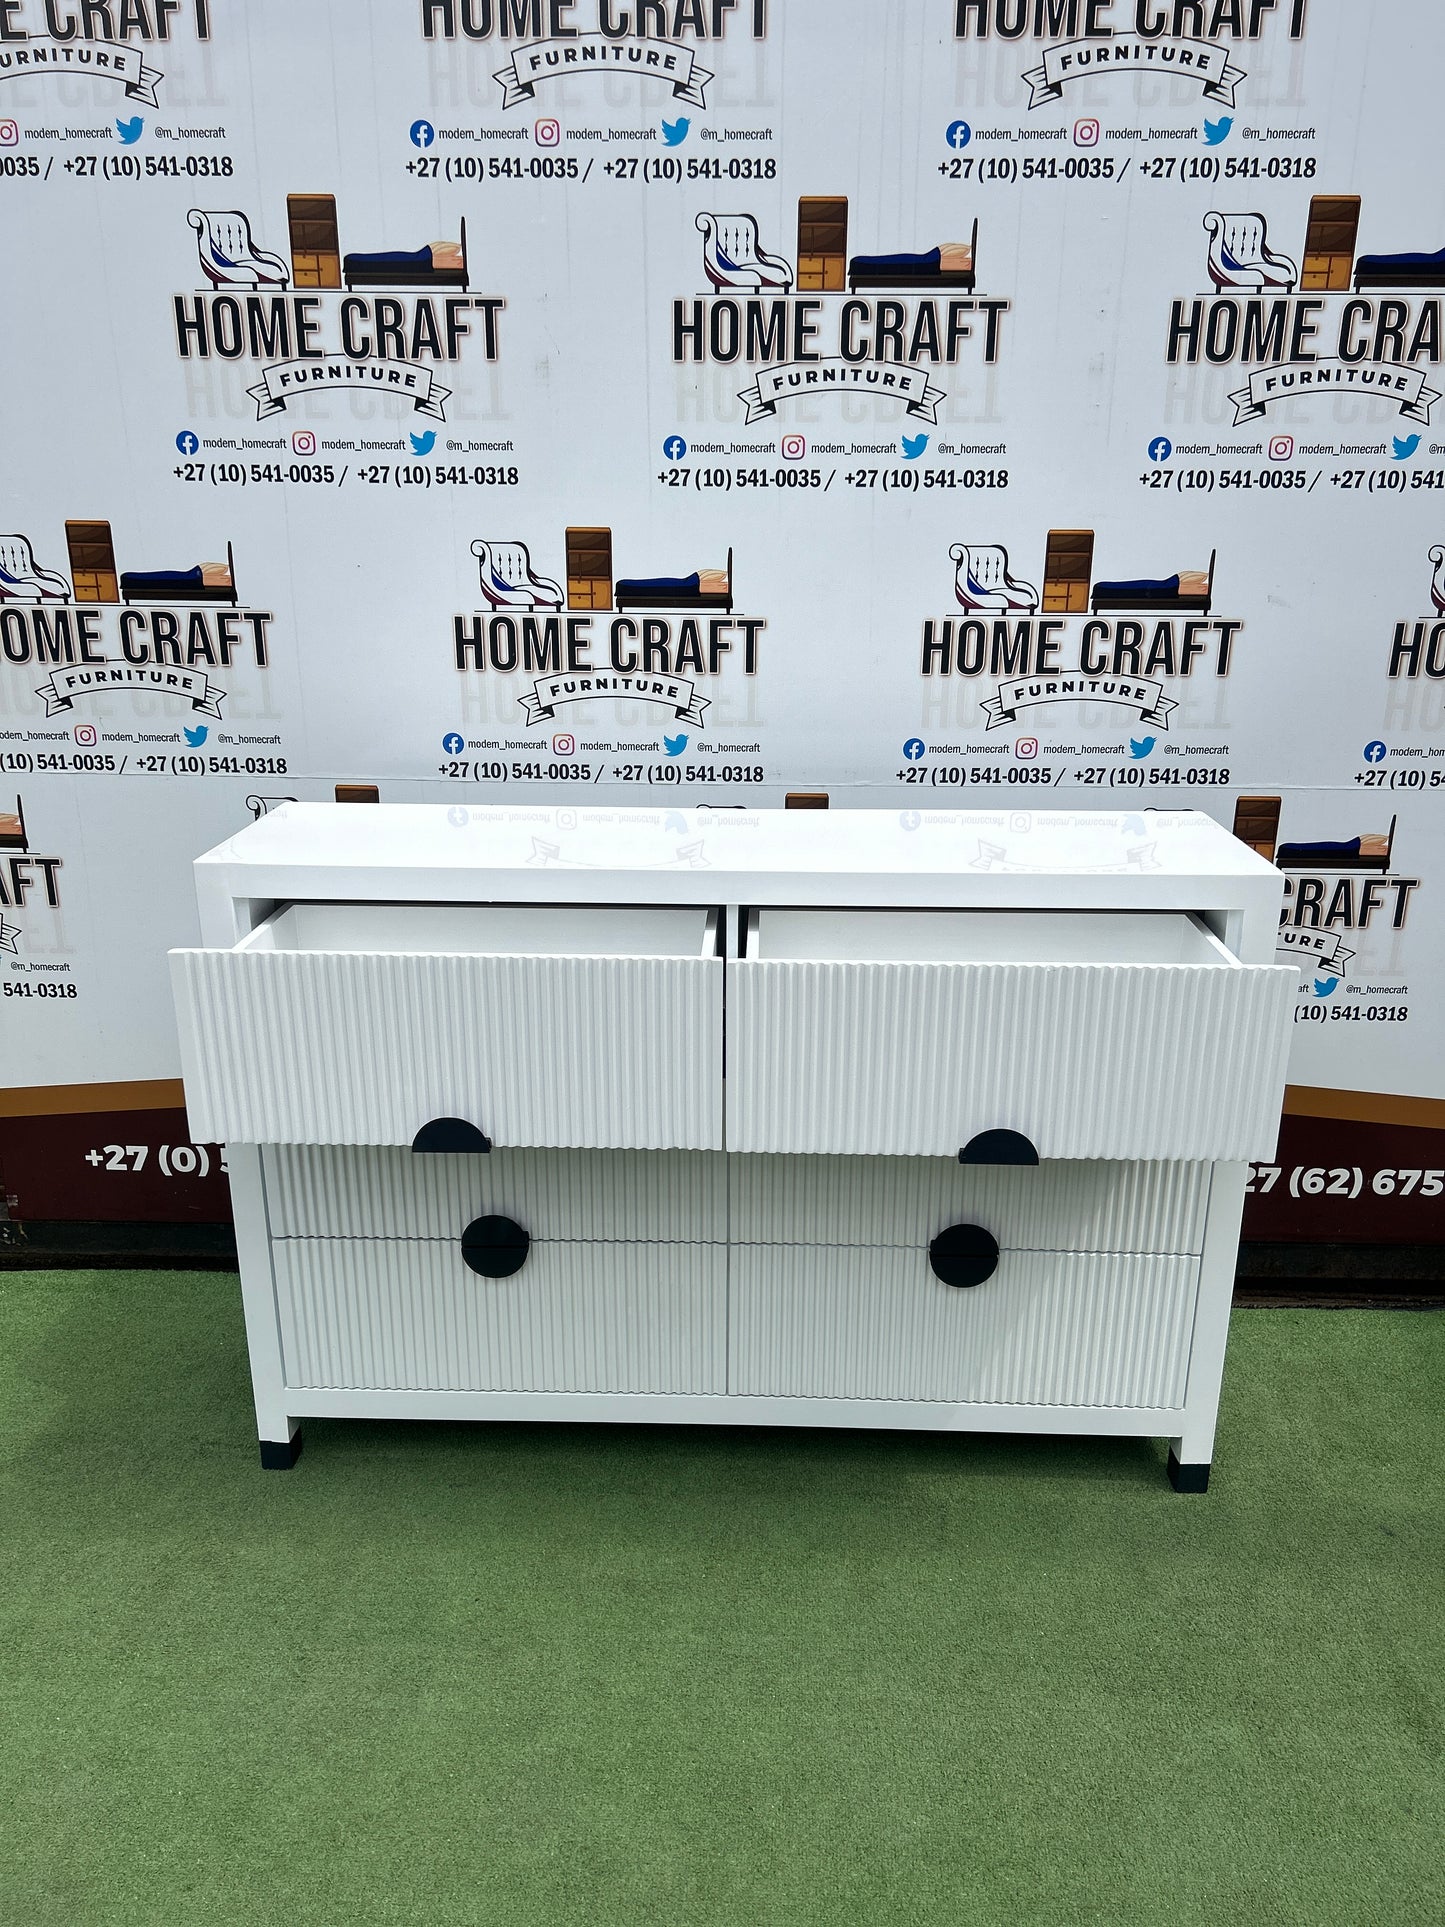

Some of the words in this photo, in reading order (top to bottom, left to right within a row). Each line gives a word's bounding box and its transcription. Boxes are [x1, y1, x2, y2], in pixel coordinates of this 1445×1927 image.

[0, 48, 126, 71] URNITURE
[529, 46, 676, 70] FURNITURE
[1061, 45, 1210, 70] FURNITURE
[155, 127, 226, 140] @m_homecraft
[701, 128, 772, 142] @m_homecraft
[1242, 127, 1315, 141] @m_homecraft
[64, 156, 97, 176] +27
[103, 156, 140, 180] (10)
[146, 156, 233, 176] 541-0318
[406, 157, 440, 177] +27
[446, 158, 483, 182] (10)
[489, 158, 578, 178] 541-0035
[604, 158, 638, 178] +27
[644, 158, 682, 183] (10)
[687, 159, 776, 179] 541-0318
[938, 158, 974, 178] +27
[979, 158, 1017, 183] (10)
[1022, 158, 1114, 178] 541-0035
[1140, 158, 1176, 178] +27
[1181, 158, 1219, 182] (10)
[1225, 157, 1316, 178] 541-0318
[174, 296, 322, 360] HOME
[341, 298, 503, 360] CRAFT
[674, 300, 822, 364] HOME
[841, 300, 1007, 362] CRAFT
[1167, 300, 1325, 365] HOME
[1338, 300, 1445, 362] CRA
[280, 366, 416, 387] FURNITURE
[773, 369, 911, 390] FURNITURE
[1266, 369, 1408, 391] FURNITURE
[446, 440, 513, 452] @m_homecraft
[938, 443, 1006, 455] @m_homecraft
[174, 464, 205, 481] +27
[211, 464, 246, 486] (10)
[251, 465, 334, 483] 541-0035
[358, 466, 389, 483] +27
[395, 466, 431, 488] (10)
[436, 467, 518, 485] 541-0318
[658, 469, 690, 486] +27
[696, 469, 731, 491] (10)
[736, 469, 821, 487] 541-0035
[845, 470, 878, 487] +27
[883, 470, 919, 492] (10)
[924, 470, 1008, 488] 541-0318
[1140, 470, 1173, 488] +27
[1178, 470, 1214, 492] (10)
[1219, 470, 1306, 488] 541-0035
[1330, 470, 1365, 488] +27
[1369, 471, 1406, 493] (10)
[1411, 471, 1444, 488] 541
[0, 609, 105, 662] OME
[120, 611, 270, 666] CRAFT
[455, 616, 593, 673] HOME
[611, 618, 764, 673] CRAFT
[922, 620, 1063, 677] HOME
[1081, 621, 1240, 675] CRAFT
[1388, 622, 1445, 678] HO
[66, 670, 192, 689] FURNITURE
[550, 678, 678, 698] FURNITURE
[1015, 681, 1146, 700] FURNITURE
[218, 734, 281, 745] @m_homecraft
[697, 743, 760, 753] @m_homecraft
[1164, 745, 1229, 756] @m_homecraft
[0, 753, 33, 773] (10)
[37, 754, 115, 770] 541-0035
[137, 756, 166, 771] +27
[172, 756, 205, 776] (10)
[210, 757, 287, 774] 541-0318
[439, 762, 469, 777] +27
[474, 763, 507, 782] (10)
[512, 763, 590, 780] 541-0035
[613, 765, 643, 780] +27
[648, 765, 681, 785] (10)
[686, 766, 763, 782] 541-0318
[896, 767, 927, 783] +27
[932, 768, 966, 787] (10)
[970, 768, 1051, 783] 541-0035
[1074, 768, 1106, 783] +27
[1110, 768, 1144, 787] (10)
[1149, 768, 1230, 784] 541-0318
[1355, 770, 1387, 786] +27
[1390, 771, 1425, 790] (10)
[3, 983, 77, 998] 541-0318
[1346, 985, 1408, 995] @m_homecraft
[1294, 1006, 1327, 1023] (10)
[1331, 1006, 1408, 1021] 541-0318
[85, 1145, 148, 1171] +27
[159, 1145, 209, 1176] (0)
[1290, 1167, 1362, 1198] (62)
